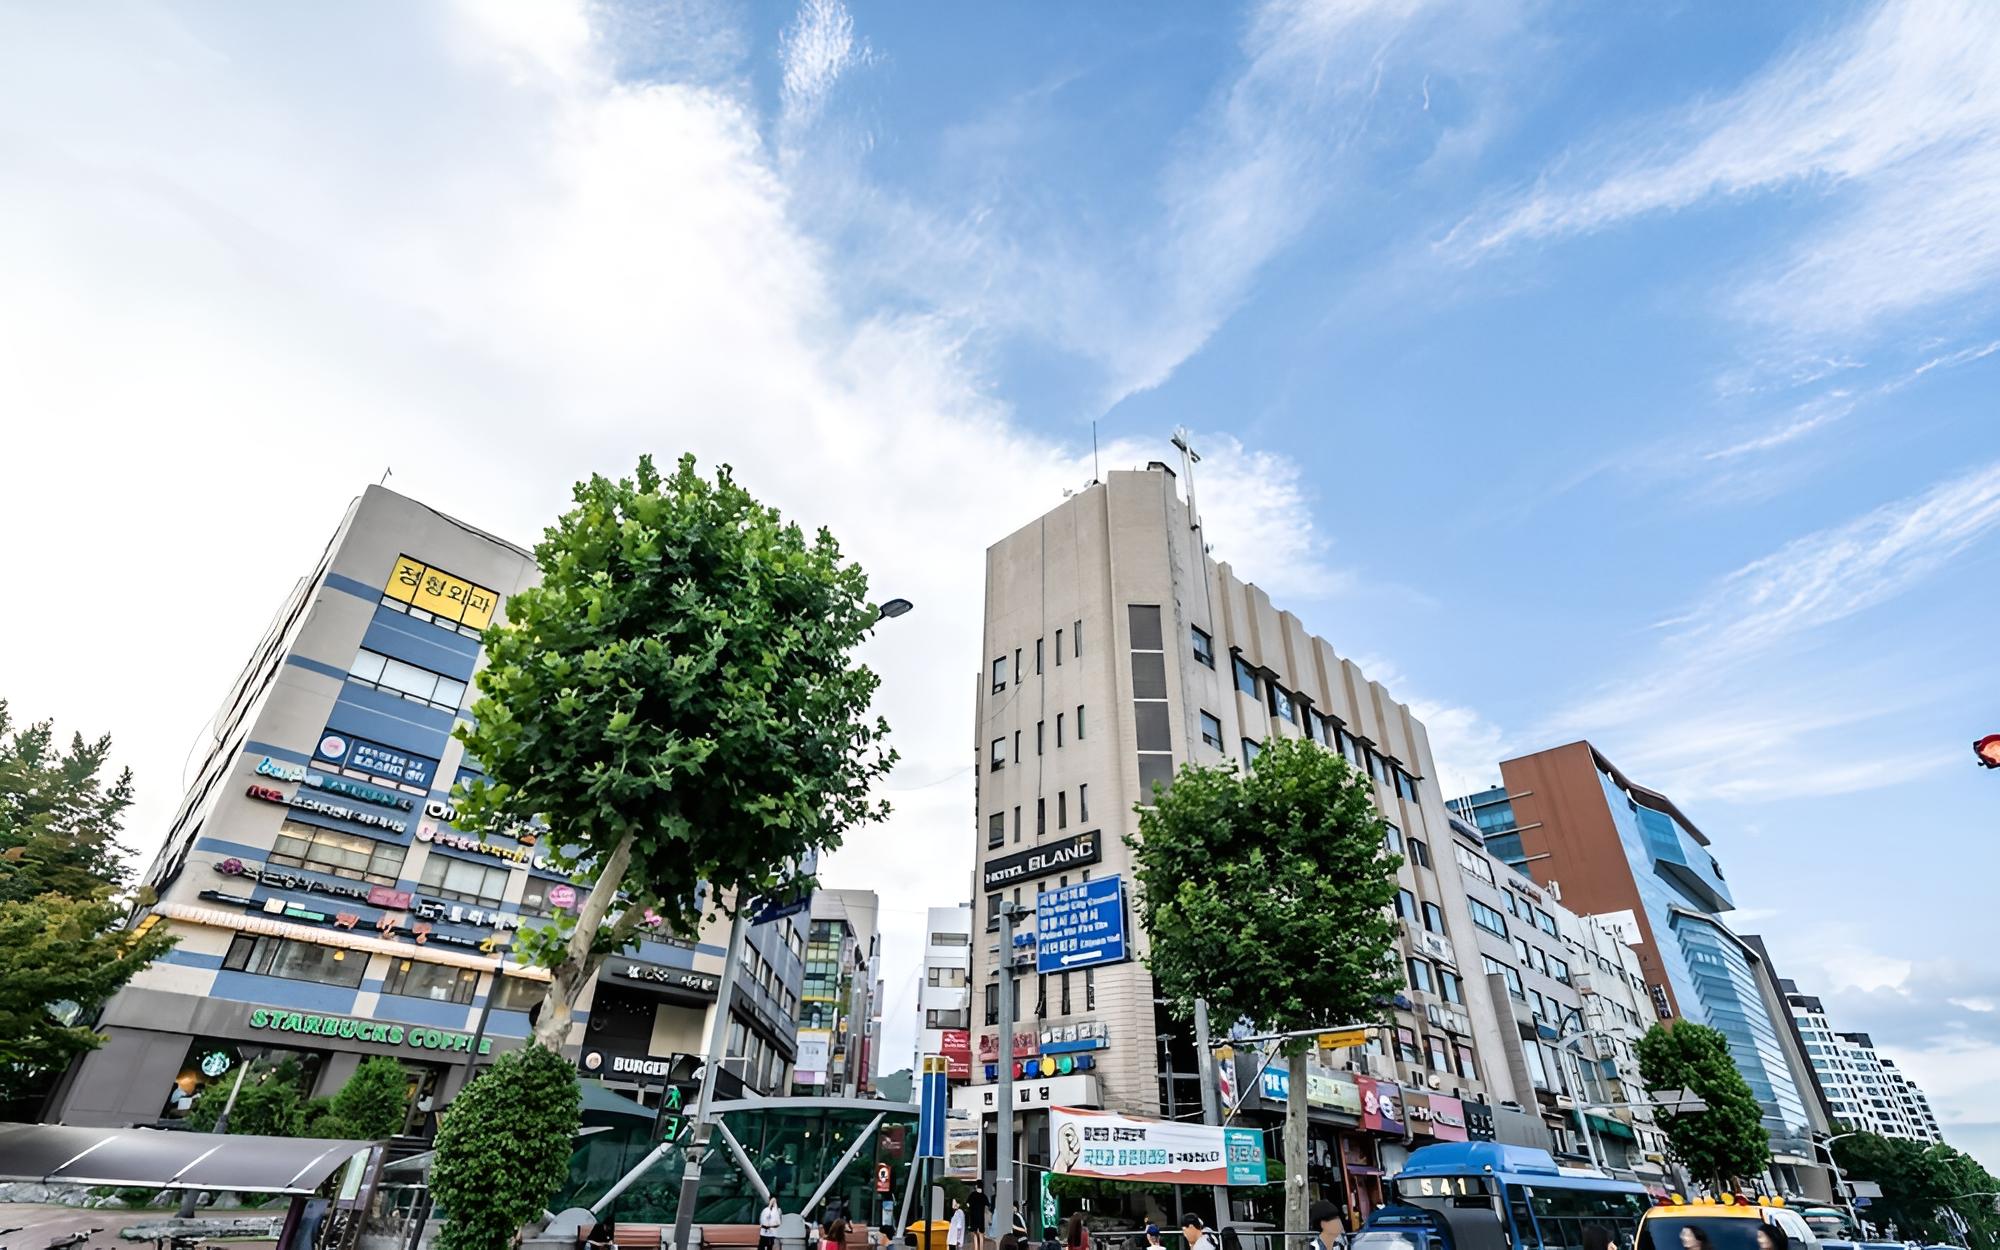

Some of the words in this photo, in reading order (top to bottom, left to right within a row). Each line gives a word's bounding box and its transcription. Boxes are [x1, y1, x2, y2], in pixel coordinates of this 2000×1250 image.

[1028, 841, 1093, 872] BLANC
[250, 1008, 403, 1044] STARBUCKS
[664, 1116, 679, 1141] 3
